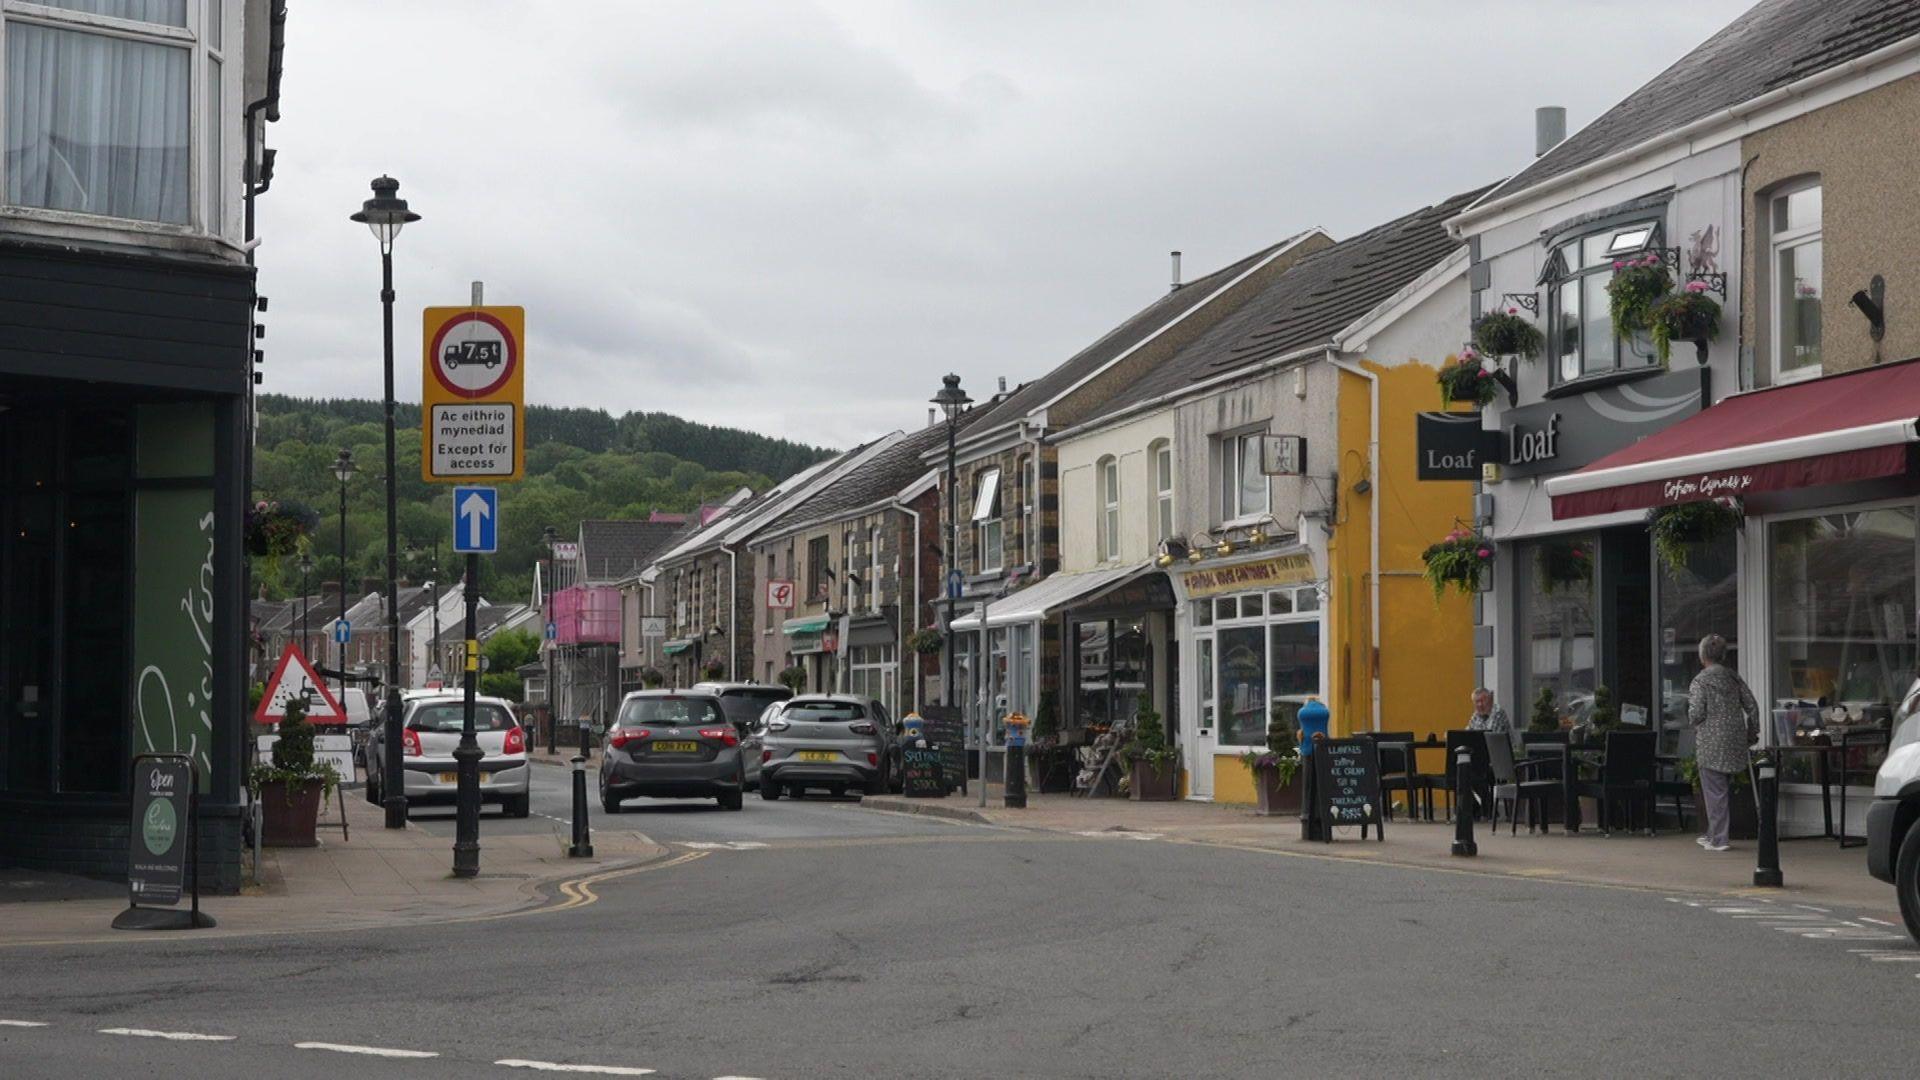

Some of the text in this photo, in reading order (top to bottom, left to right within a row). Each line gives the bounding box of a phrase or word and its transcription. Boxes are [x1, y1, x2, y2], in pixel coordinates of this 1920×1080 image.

[440, 409, 506, 422] Ac eithrio
[440, 423, 505, 438] mynediad
[1508, 412, 1559, 465] Loaf
[438, 443, 508, 456] Except for
[450, 459, 495, 469] access
[1427, 449, 1476, 469] Loaf
[149, 767, 175, 791] Open
